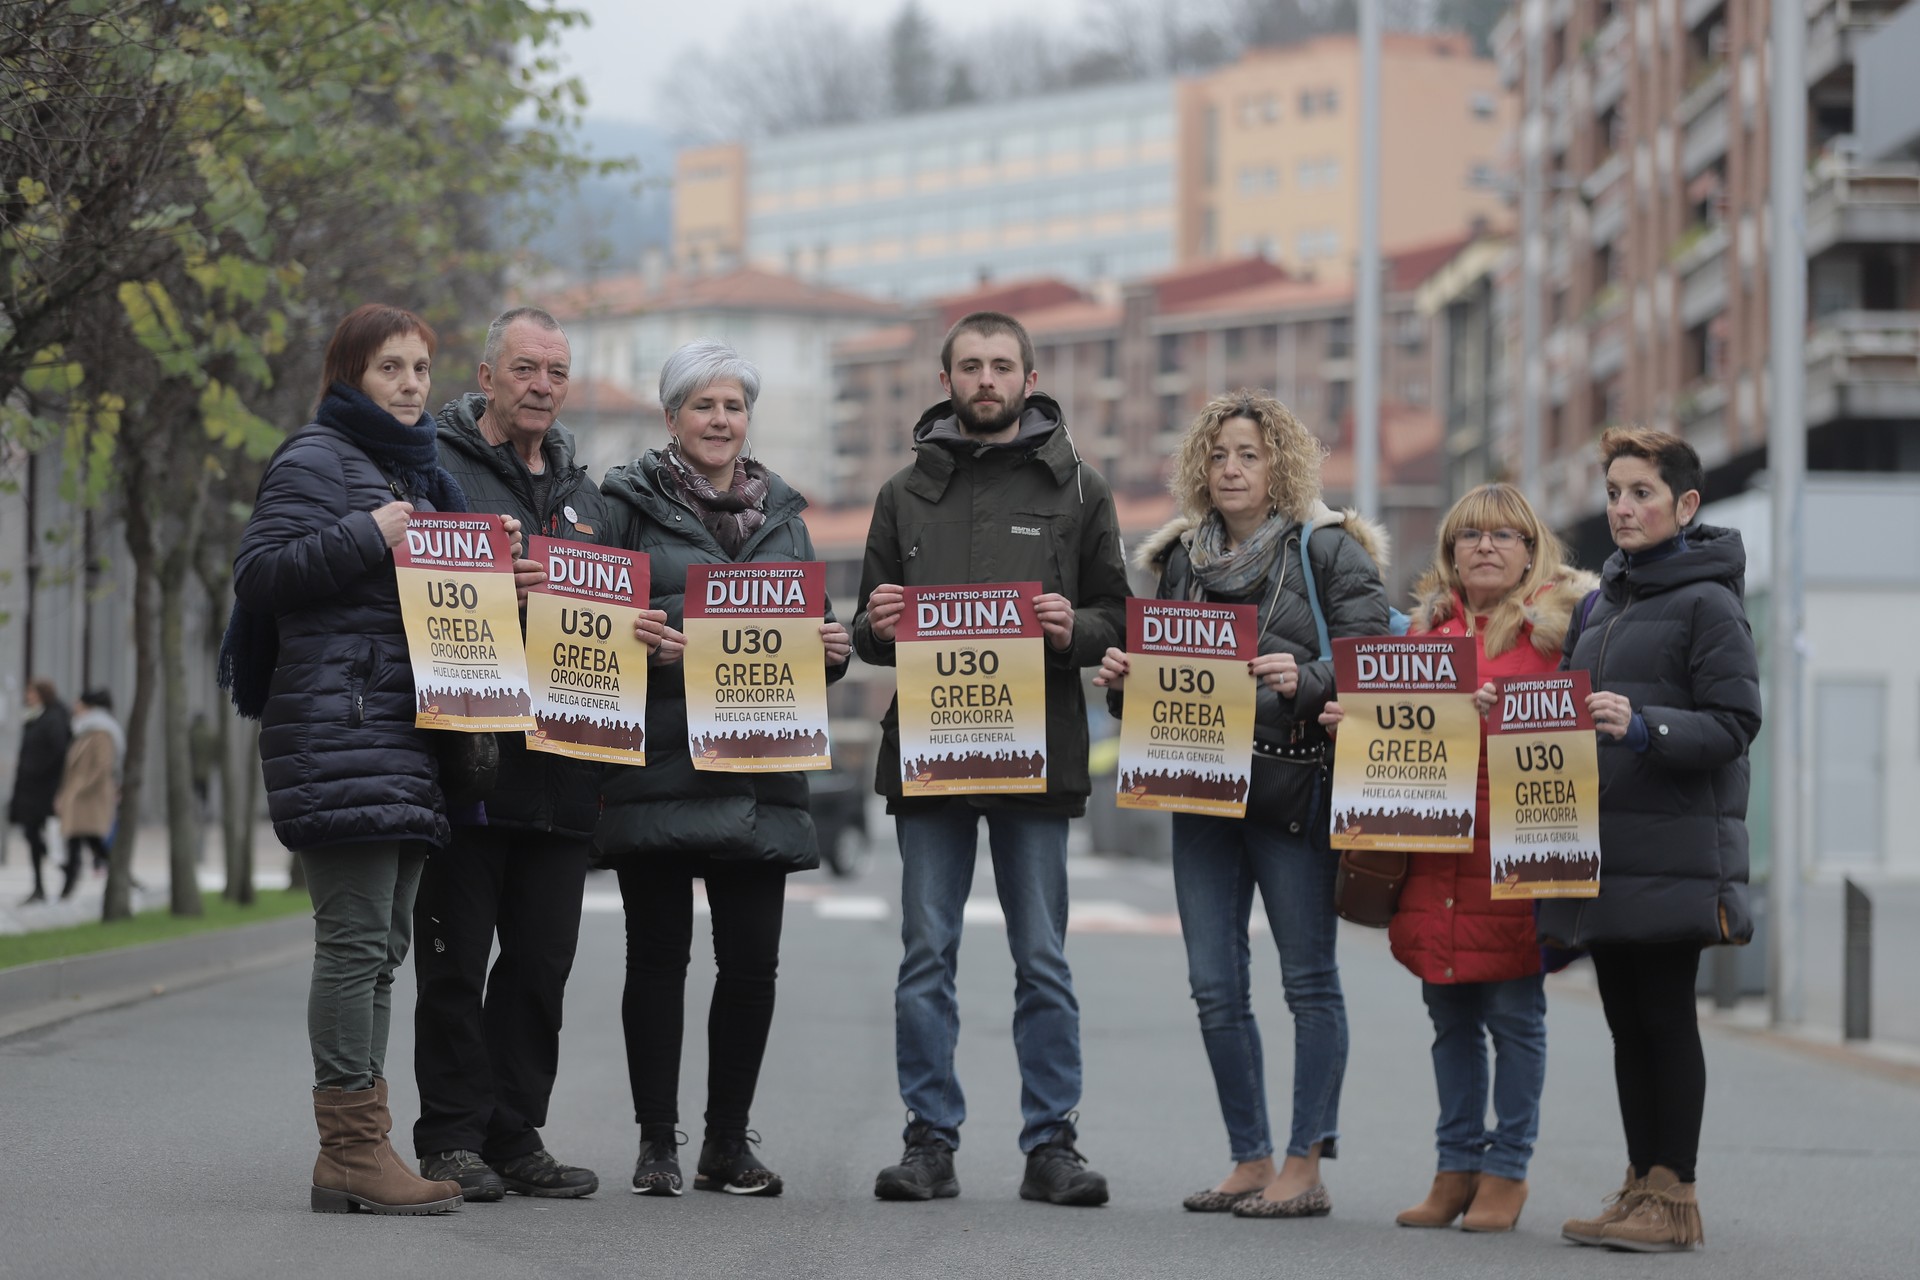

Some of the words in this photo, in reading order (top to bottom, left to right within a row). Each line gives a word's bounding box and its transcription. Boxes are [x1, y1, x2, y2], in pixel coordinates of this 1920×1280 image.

[406, 530, 494, 560] DUINA
[548, 546, 632, 566] LAN-PENTSIO-BIZITZA
[549, 556, 632, 594] DUINA
[708, 570, 804, 578] LAN-PENTSIO-BIZITZA
[427, 582, 478, 609] U30
[547, 584, 575, 593] SOBERANÍA
[576, 588, 588, 596] PARA
[614, 594, 632, 602] SOCIAL
[706, 580, 805, 605] DUINA
[917, 590, 1019, 601] LAN-PENTSIO-BIZITZA
[562, 608, 612, 640] U30
[918, 601, 1022, 629] DUINA
[1144, 606, 1235, 620] LAN-PENTSIO-BIZITZA
[427, 616, 494, 642] GREBA
[1144, 617, 1237, 648] DUINA
[431, 642, 497, 659] OROKORRA
[722, 629, 782, 654] U30
[1356, 644, 1453, 653] LAN-PENTSIO-BIZITZA
[554, 643, 620, 674] GREBA
[937, 650, 999, 676] U30
[1357, 654, 1456, 681] DUINA
[433, 667, 460, 678] HUELGA
[461, 669, 501, 679] GENERAL
[551, 669, 620, 691] OROKORRA
[716, 663, 794, 686] GREBA
[1160, 667, 1214, 694] U30
[548, 692, 579, 706] HUELGA
[581, 697, 620, 711] GENERAL
[716, 688, 795, 702] OROKORRA
[931, 684, 1013, 708] GREBA
[1503, 690, 1576, 722] DUINA
[715, 712, 750, 722] HUELGA
[754, 712, 798, 721] GENERAL
[931, 709, 1013, 725] OROKORRA
[1153, 700, 1225, 727] GREBA
[1376, 705, 1435, 730] U30
[930, 734, 968, 744] HUELGA
[971, 732, 1016, 743] GENERAL
[1151, 726, 1224, 744] OROKORRA
[1147, 749, 1184, 760] HUELGA
[1186, 751, 1224, 764] GENERAL
[1369, 739, 1447, 762] GREBA
[1516, 744, 1564, 772] U30
[1366, 764, 1447, 780] OROKORRA
[1362, 788, 1401, 799] HUELGA
[1404, 789, 1447, 800] GENERAL
[1516, 780, 1576, 805] GREBA
[1516, 807, 1577, 823] OROKORRA
[1515, 832, 1548, 844] HUELGA
[1550, 831, 1579, 843] GENERAL
